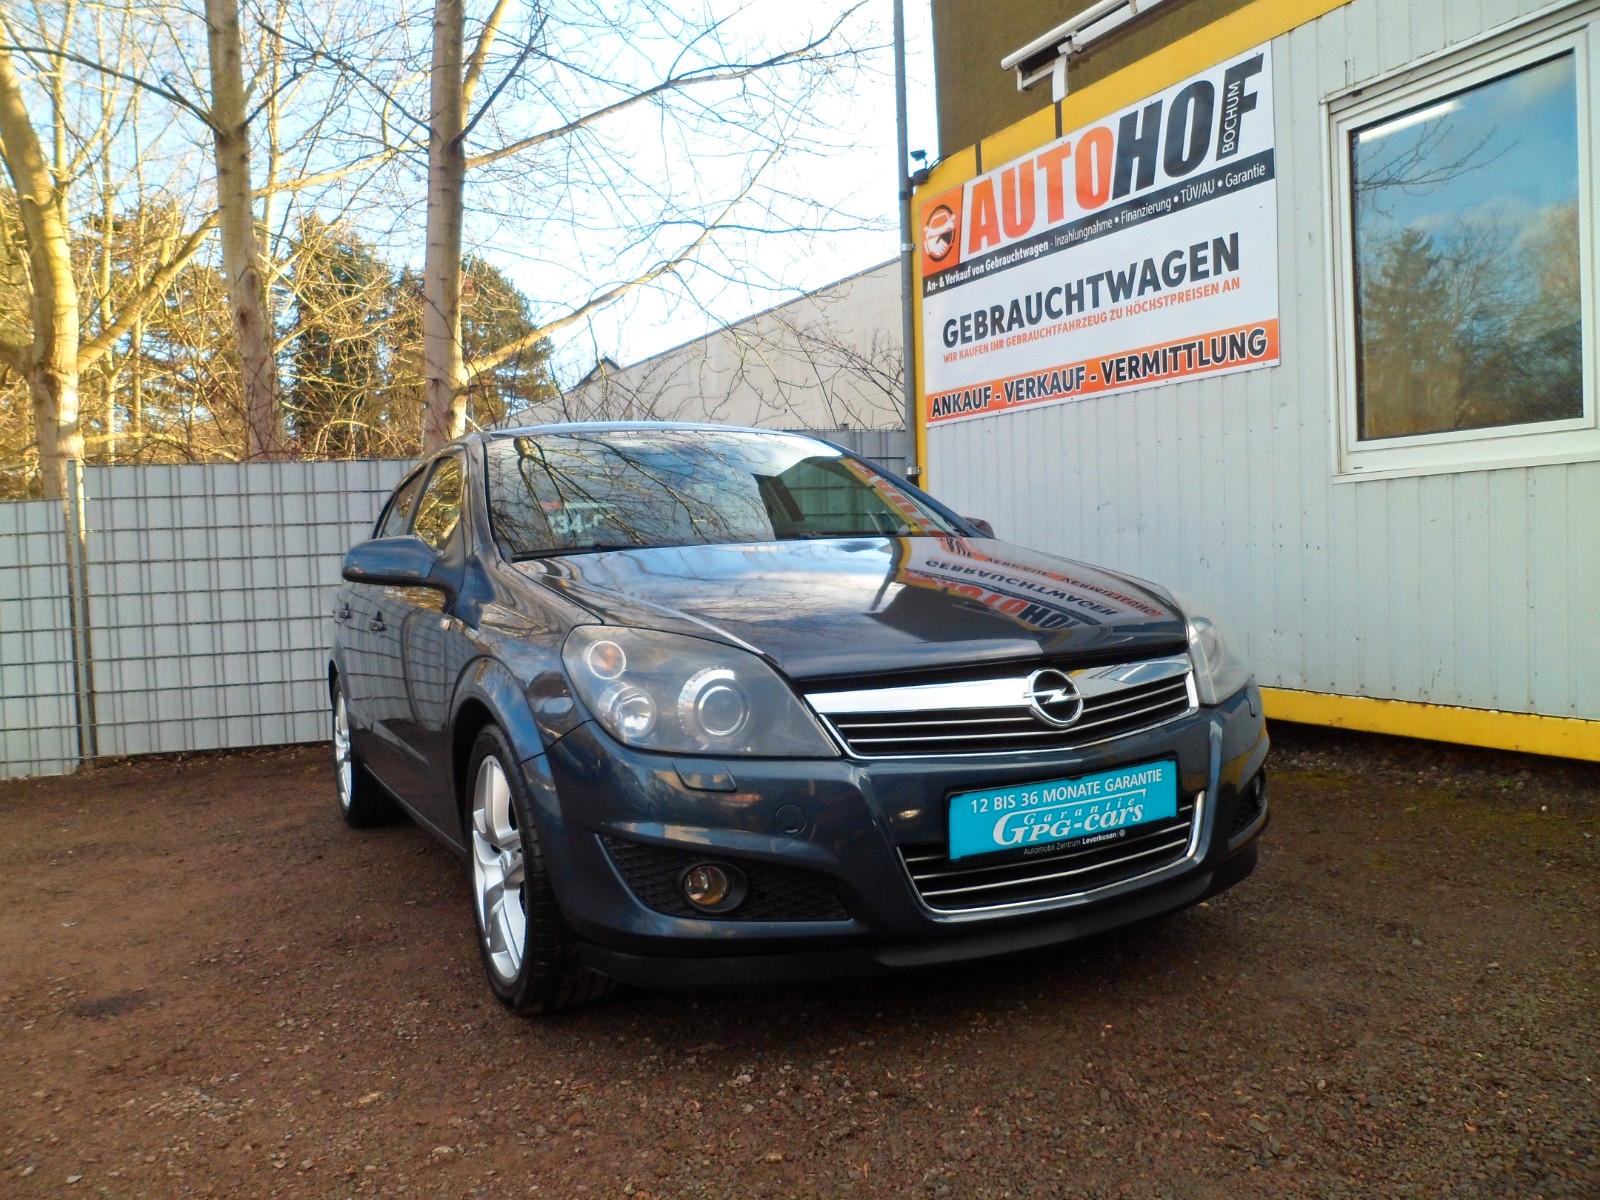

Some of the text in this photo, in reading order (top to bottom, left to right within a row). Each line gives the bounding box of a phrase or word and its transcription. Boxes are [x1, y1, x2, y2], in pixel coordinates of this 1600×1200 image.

[968, 53, 1264, 254] AUTOHOF
[1222, 80, 1241, 154] BOCHUM
[926, 280, 939, 293] An-
[939, 276, 945, 287] &
[945, 266, 972, 284] Verkauf
[971, 264, 985, 275] von
[985, 240, 1049, 271] Gebrauchtwagen
[1054, 219, 1113, 247] Inzahlungnahme
[1120, 197, 1172, 224] Finanzierung
[1181, 179, 1215, 202] TÜV/AU
[1225, 163, 1266, 188] Garantie
[943, 232, 1240, 348] GEBRAUCHTWAGEN
[943, 277, 1240, 364] WIR KAUFEN IHR GEBRAUCHTFAHRZEUG ZU HÖCHSTPREISEN AN
[931, 386, 992, 418] ANKAUF
[1003, 366, 1086, 403] VERKAUF
[1101, 328, 1267, 385] VERMITTLUNG
[971, 769, 1162, 814] 12 BIS 36 MONATE GARANTIE
[1056, 839, 1081, 850] Zentrum
[1082, 831, 1117, 845] Leverkusen
